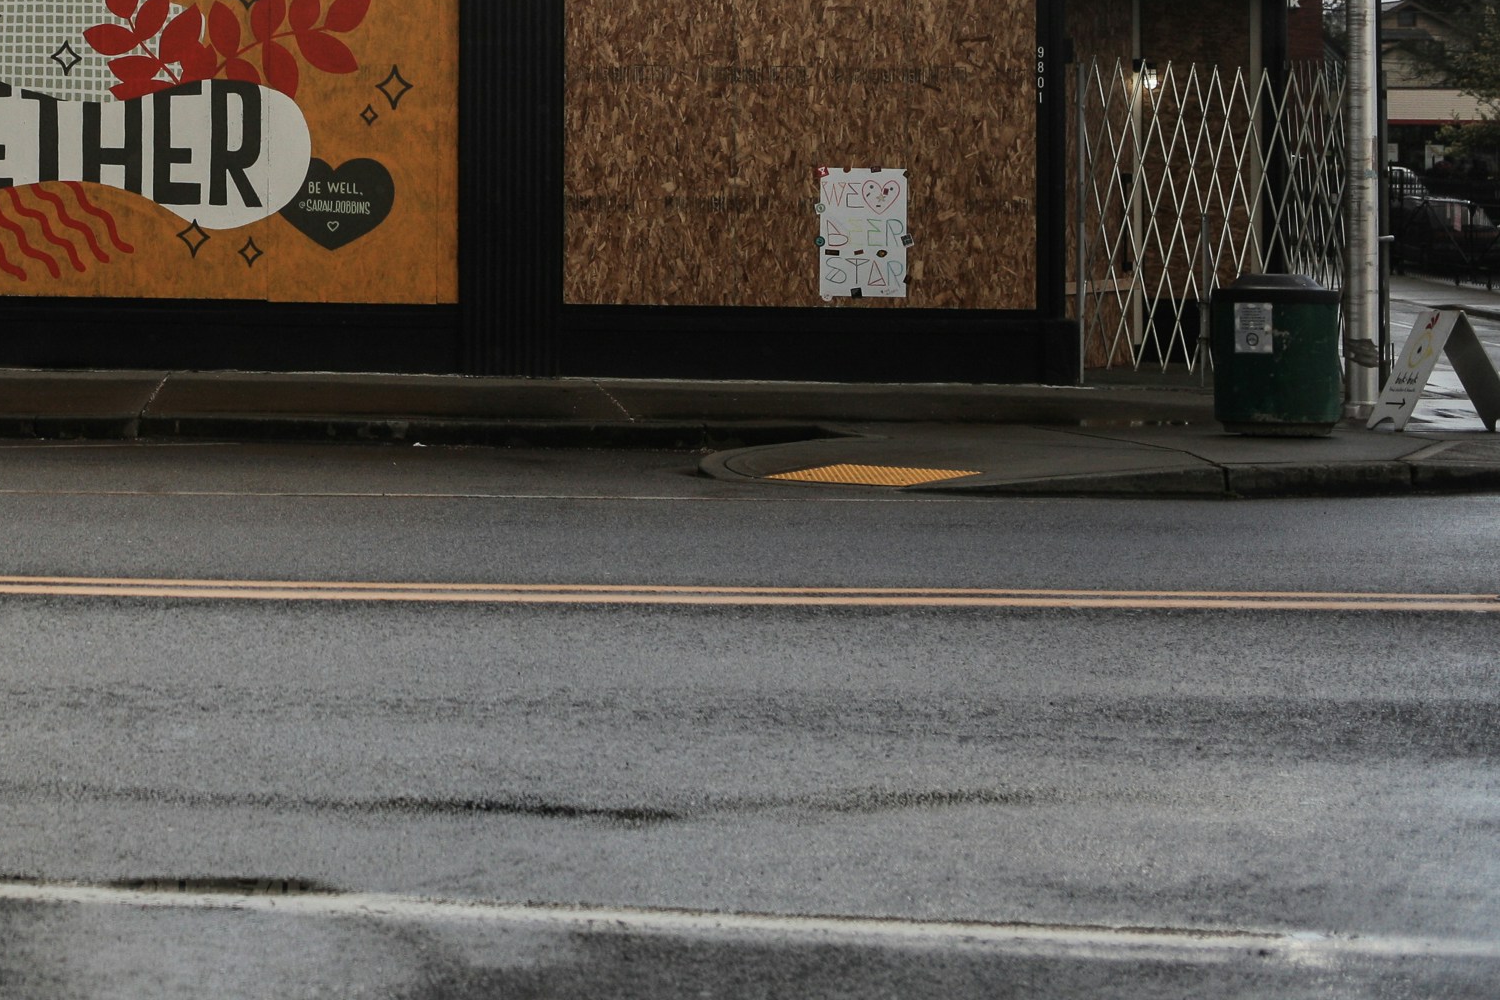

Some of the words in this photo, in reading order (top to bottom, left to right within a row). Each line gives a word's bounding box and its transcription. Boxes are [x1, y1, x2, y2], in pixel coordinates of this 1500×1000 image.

[1037, 46, 1045, 104] 9801
[308, 181, 321, 194] BE
[821, 181, 864, 209] WE
[826, 217, 904, 247] BEER
[825, 257, 904, 288] STAR
